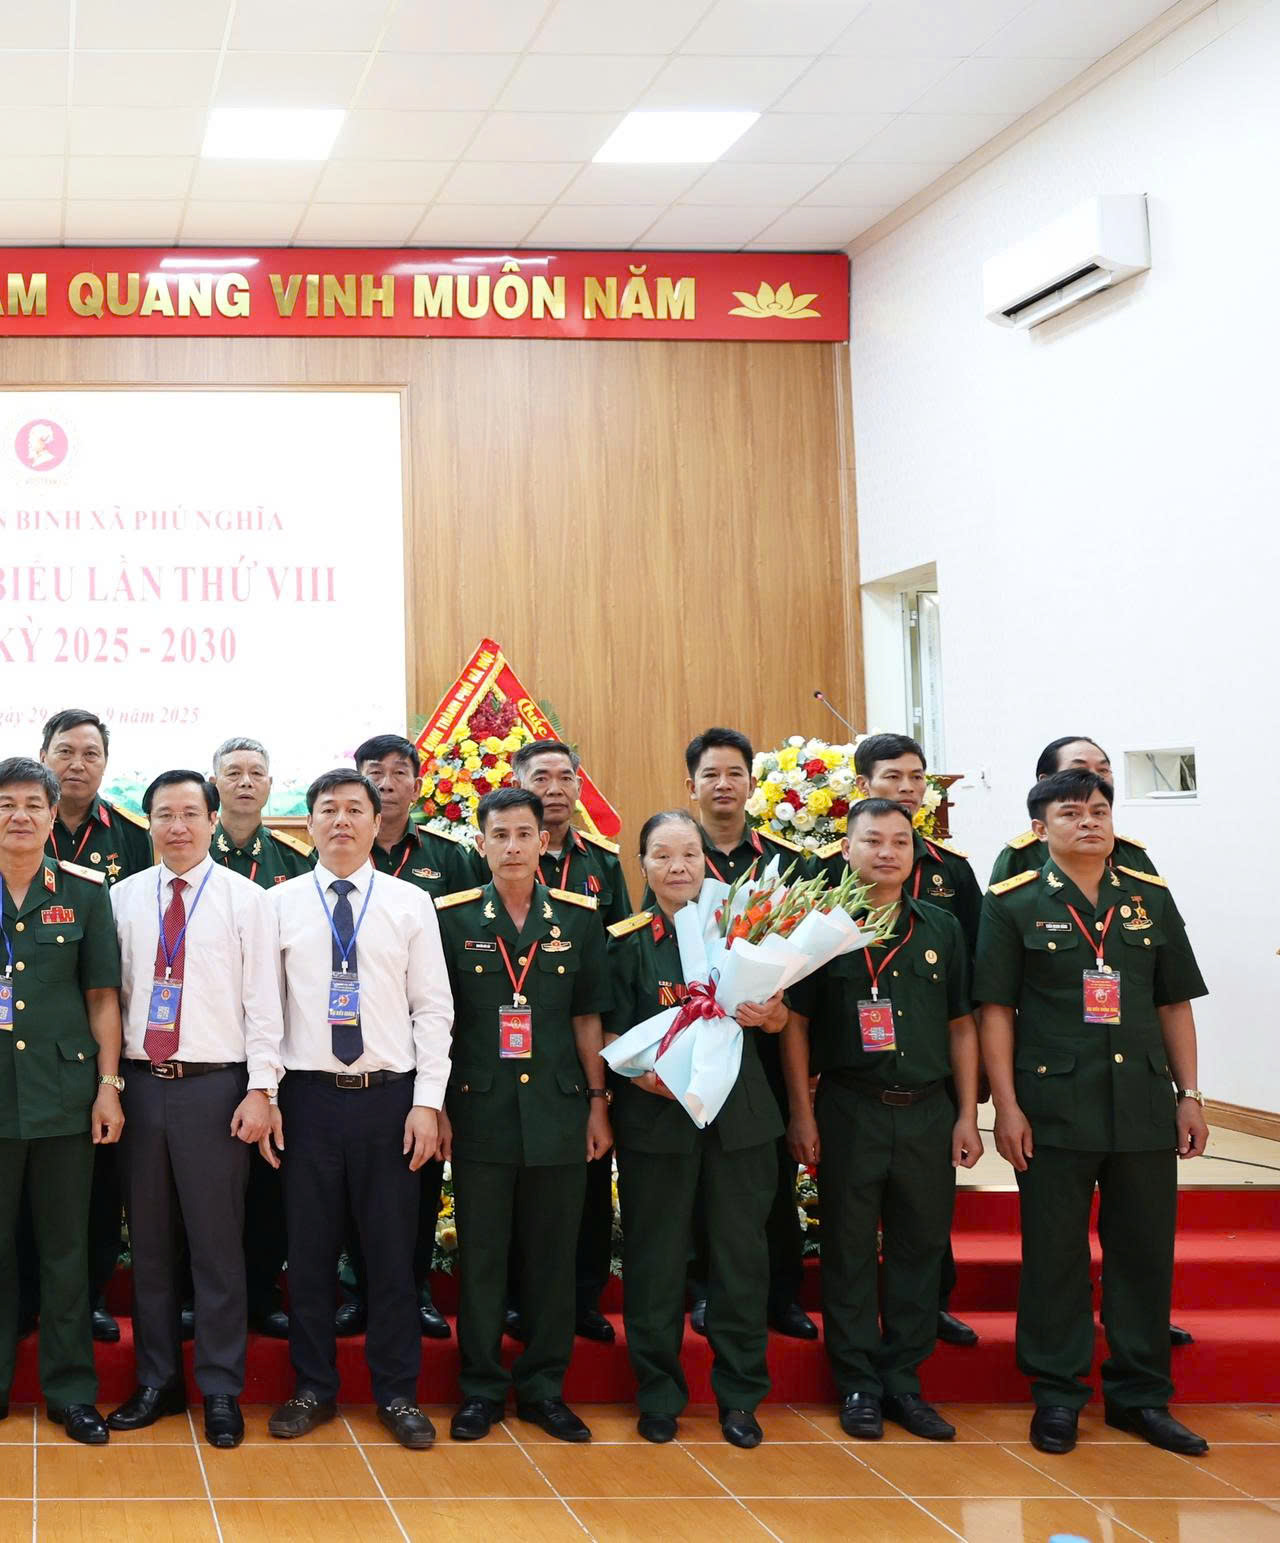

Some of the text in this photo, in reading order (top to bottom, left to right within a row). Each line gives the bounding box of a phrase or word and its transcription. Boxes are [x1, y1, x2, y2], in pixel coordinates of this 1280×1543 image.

[69, 272, 250, 317] QUANG
[270, 274, 394, 316] VINH
[414, 261, 566, 320] MUÔN
[584, 265, 695, 319] NĂM
[16, 510, 80, 530] BINH
[90, 505, 125, 530] XÃ
[135, 504, 185, 530] PHÚ
[196, 506, 283, 531] NGHĨA
[88, 555, 161, 602] LẦN
[174, 554, 258, 602] THỨ
[264, 566, 336, 602] VIII
[54, 626, 128, 664] 2025
[160, 626, 236, 664] 2030
[160, 707, 200, 724] 2025
[517, 698, 548, 738] Chúc
